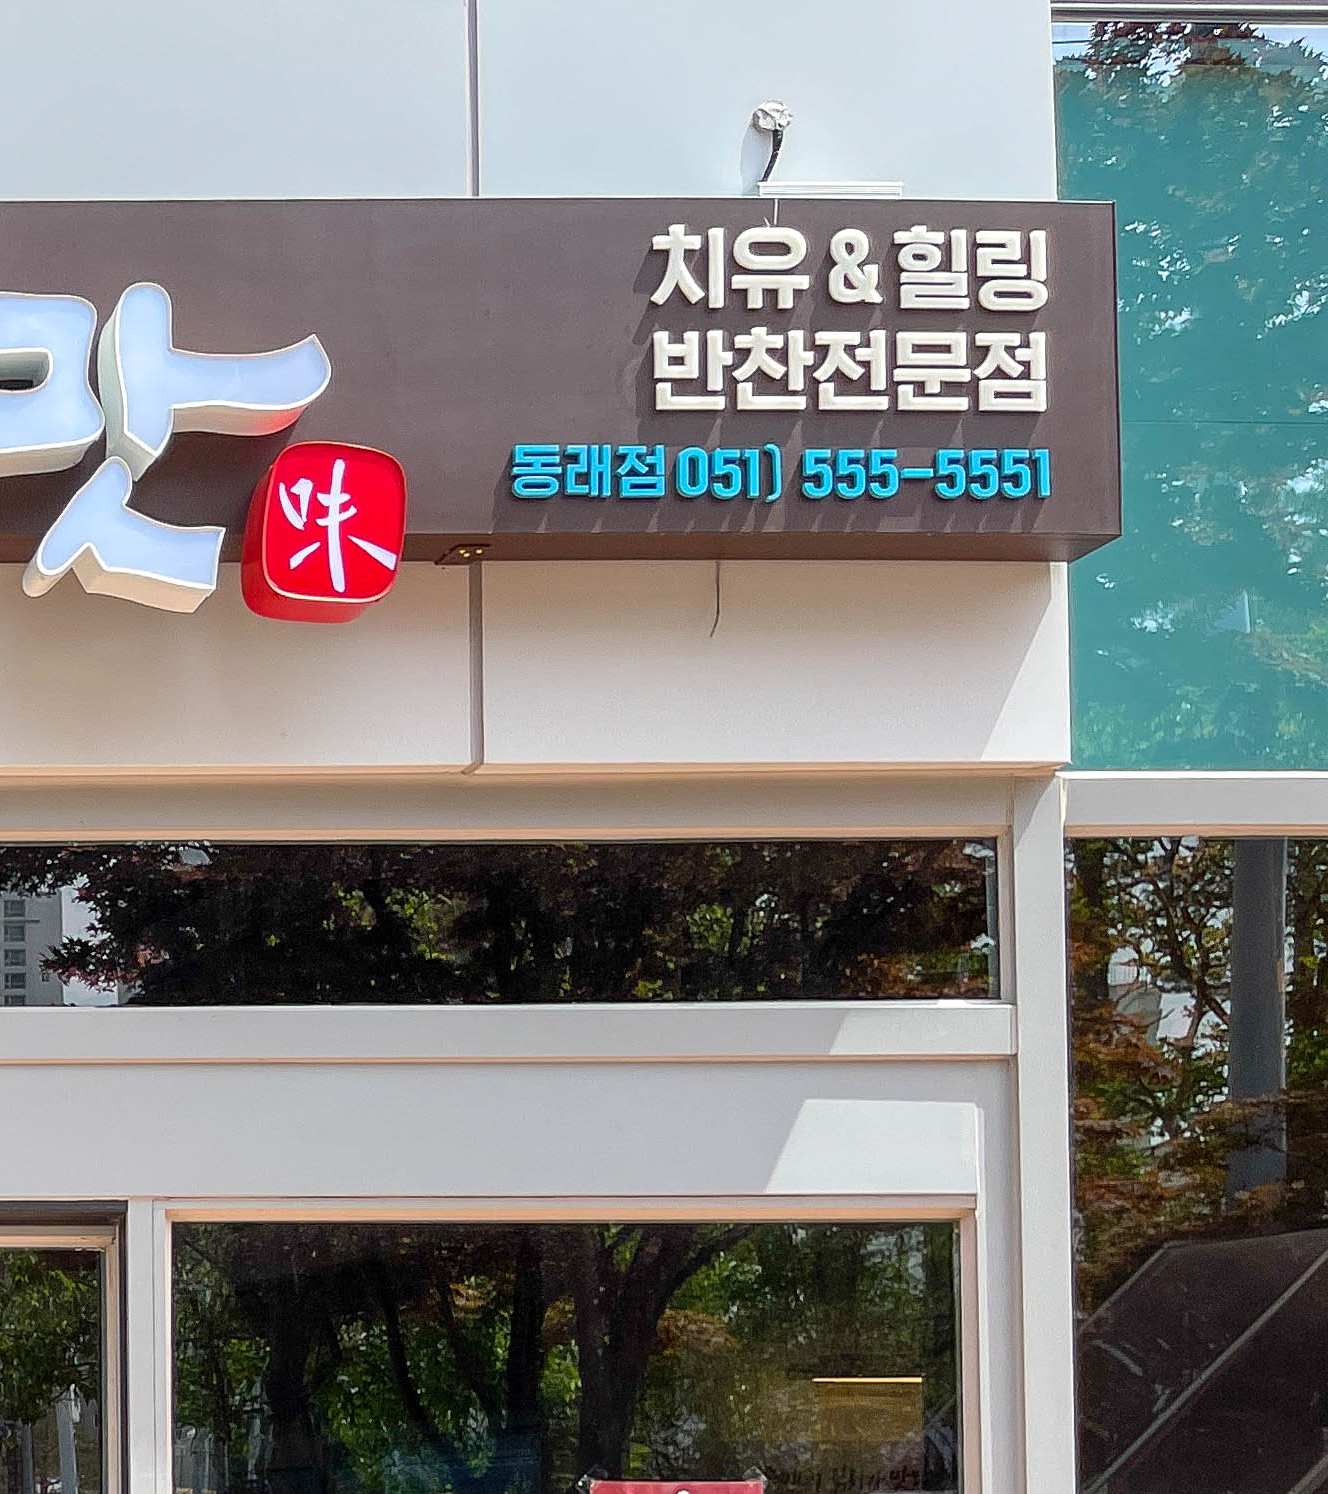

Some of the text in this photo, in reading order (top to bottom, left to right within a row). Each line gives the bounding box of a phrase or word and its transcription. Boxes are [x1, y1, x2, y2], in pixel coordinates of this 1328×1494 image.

[650, 224, 1049, 311] 치유 & 힐링
[653, 326, 1048, 412] 반찬전문점
[511, 443, 1051, 503] 동래점 051) 555-5551
